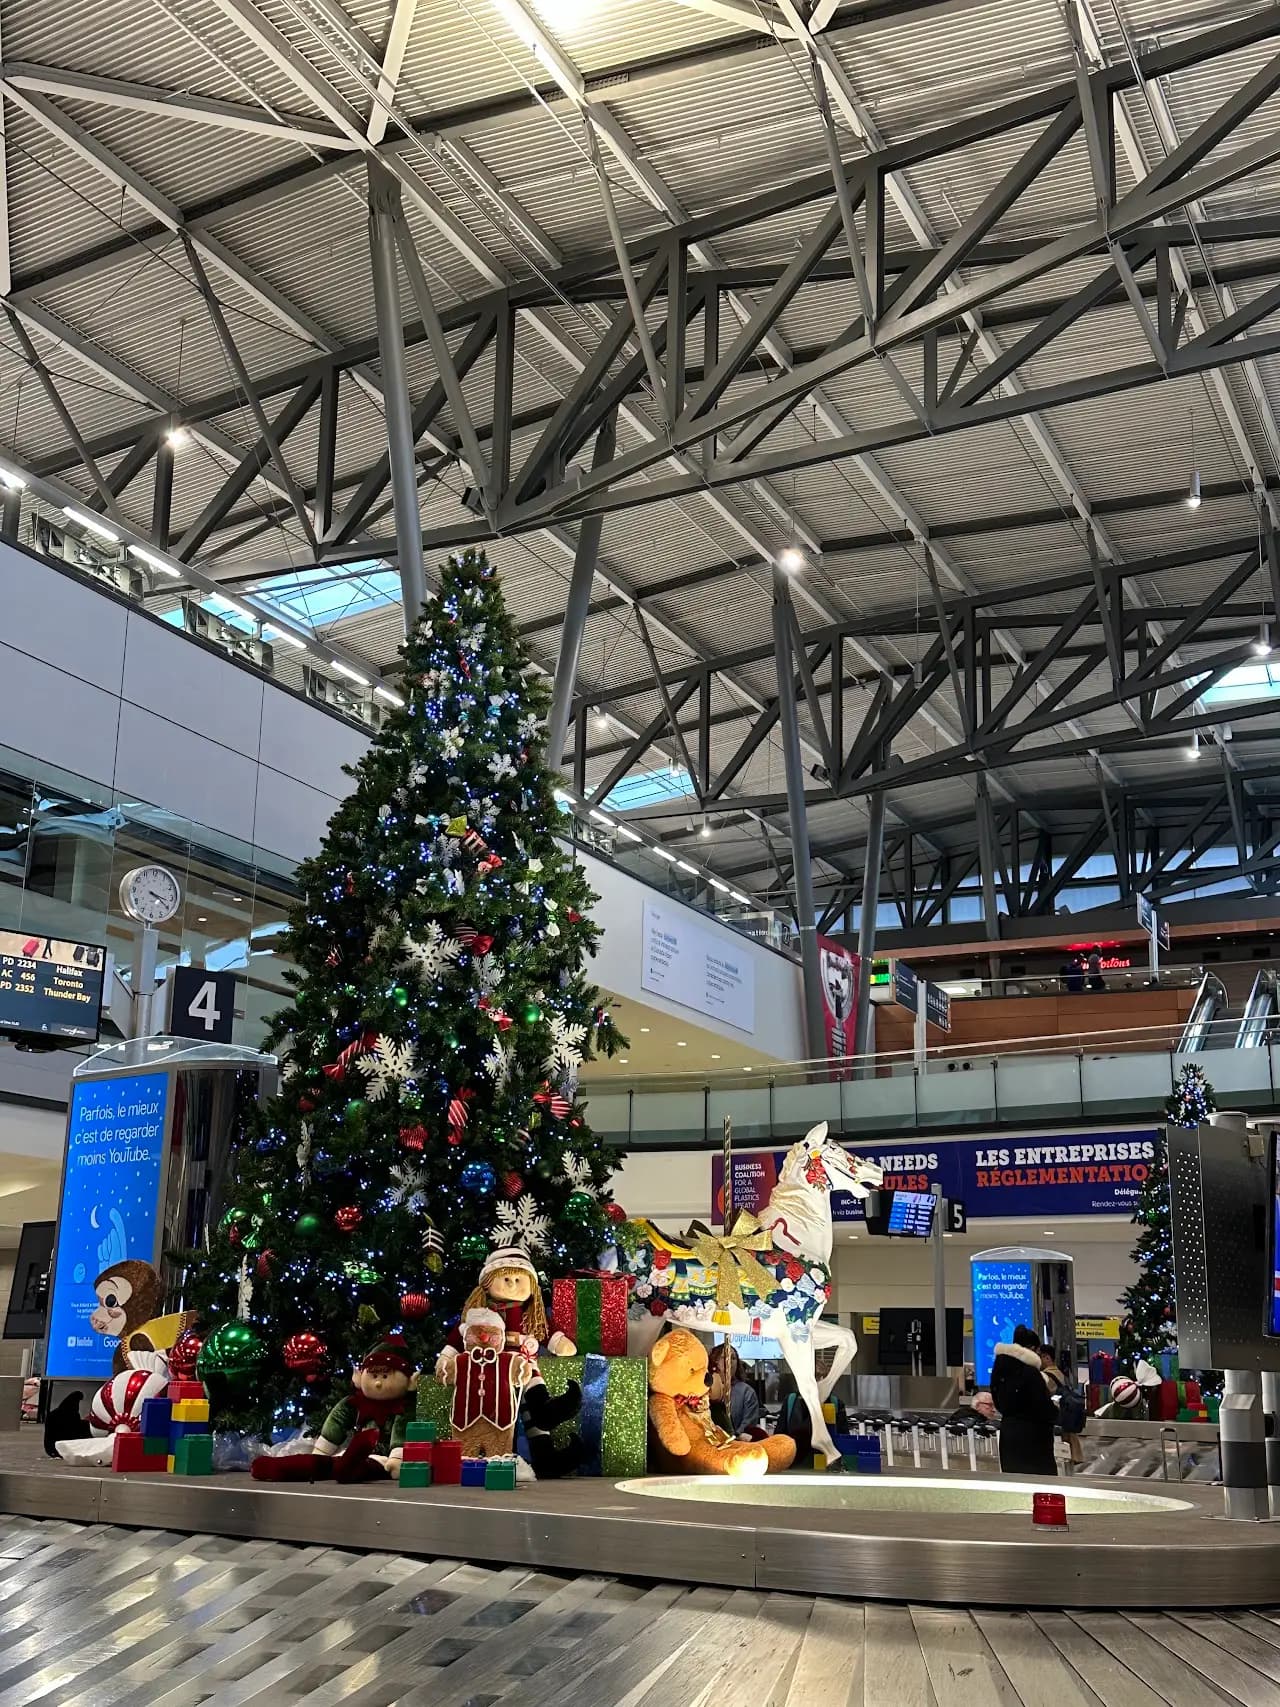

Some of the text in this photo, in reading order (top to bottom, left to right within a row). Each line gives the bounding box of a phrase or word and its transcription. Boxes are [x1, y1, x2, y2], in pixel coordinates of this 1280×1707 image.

[152, 869, 158, 877] 12
[2, 956, 83, 977] PD 2234 Halifax
[1, 969, 84, 989] AC 456 Toronto
[15, 983, 35, 993] 2352
[44, 988, 76, 999] Thunder
[76, 992, 91, 1004] Bay
[188, 980, 221, 1031] 4
[80, 1102, 158, 1121] Parfois, le mieux
[75, 1122, 159, 1145] c'est de regarder
[77, 1146, 151, 1166] moins YouTube.
[879, 1153, 938, 1172] NEEDS
[976, 1142, 1154, 1167] LES ENTREPRISES
[734, 1171, 766, 1179] COALITION
[881, 1174, 929, 1191] ULES
[734, 1194, 760, 1202] PLASTICS
[953, 1203, 964, 1229] 5
[104, 1336, 121, 1347] Goo
